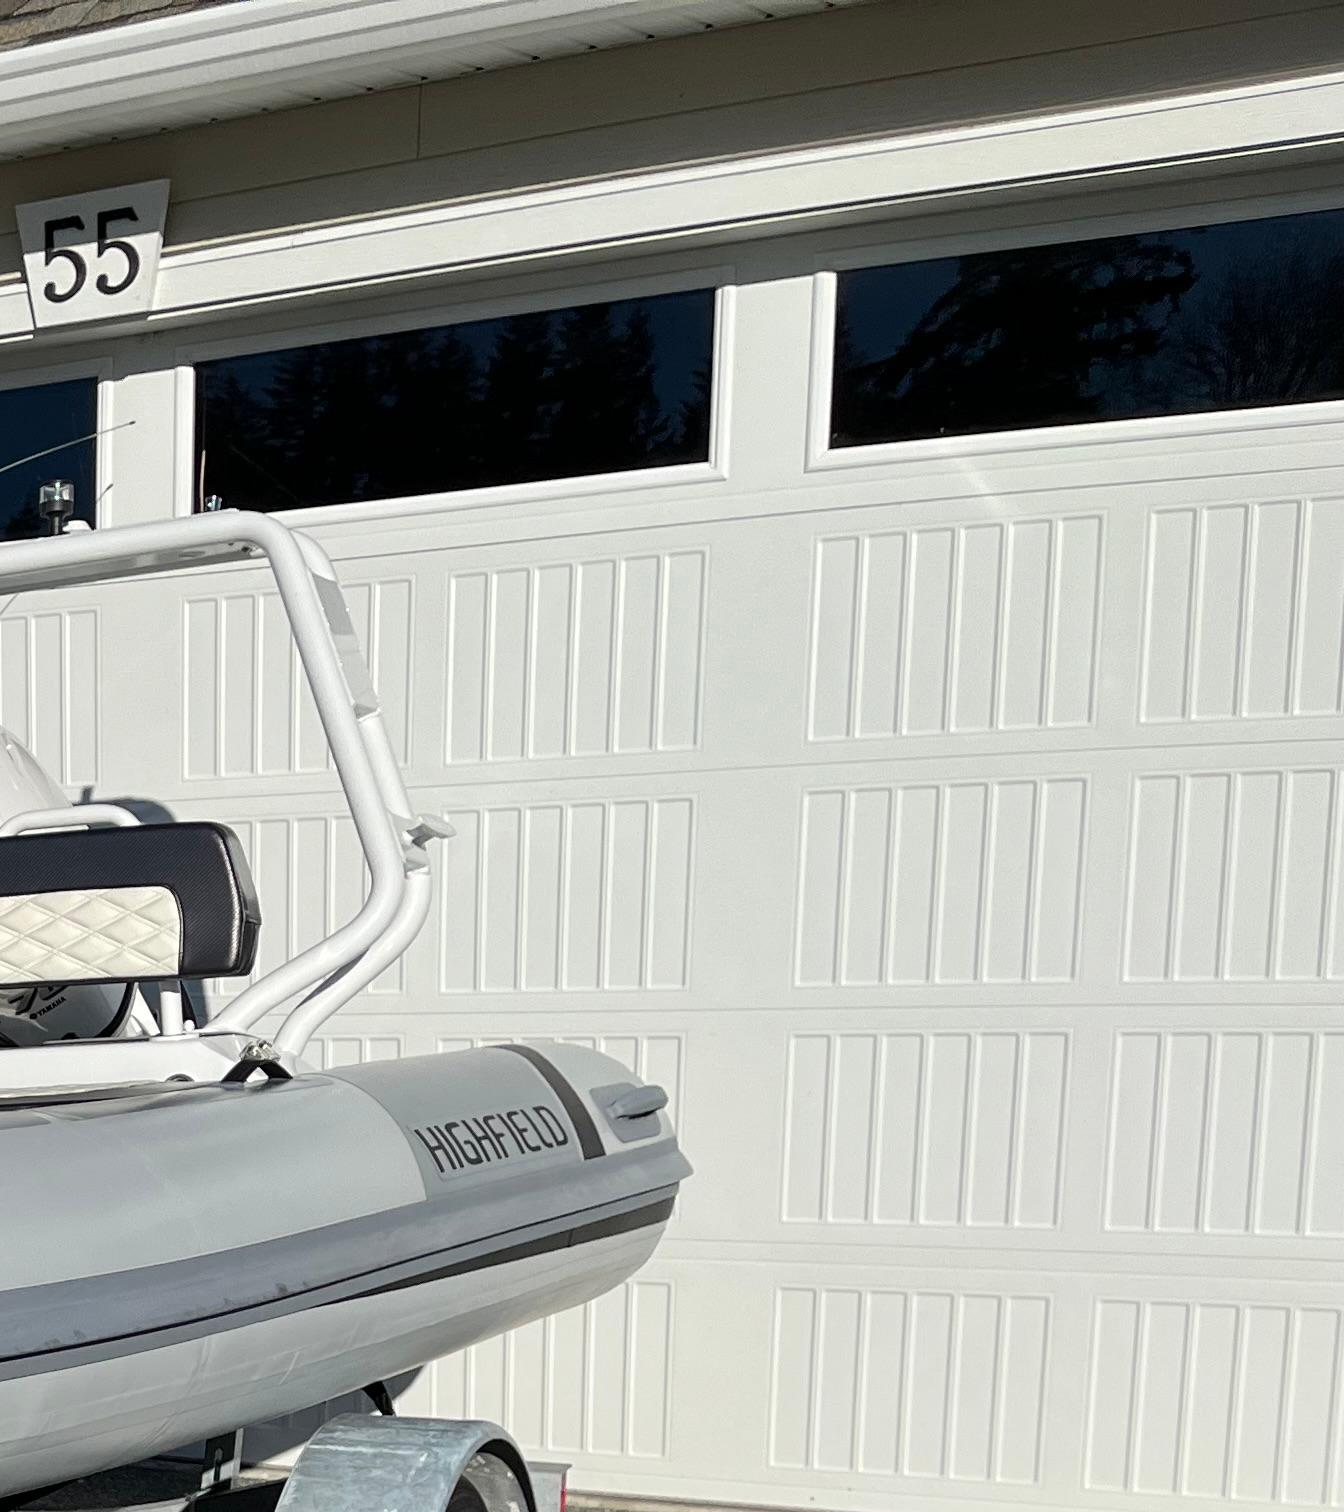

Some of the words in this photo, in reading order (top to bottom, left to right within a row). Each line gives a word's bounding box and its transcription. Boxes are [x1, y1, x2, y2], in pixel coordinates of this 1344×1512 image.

[44, 207, 140, 303] 55
[37, 996, 67, 1017] YAMAHA
[414, 1105, 569, 1173] HIGHFIELD
